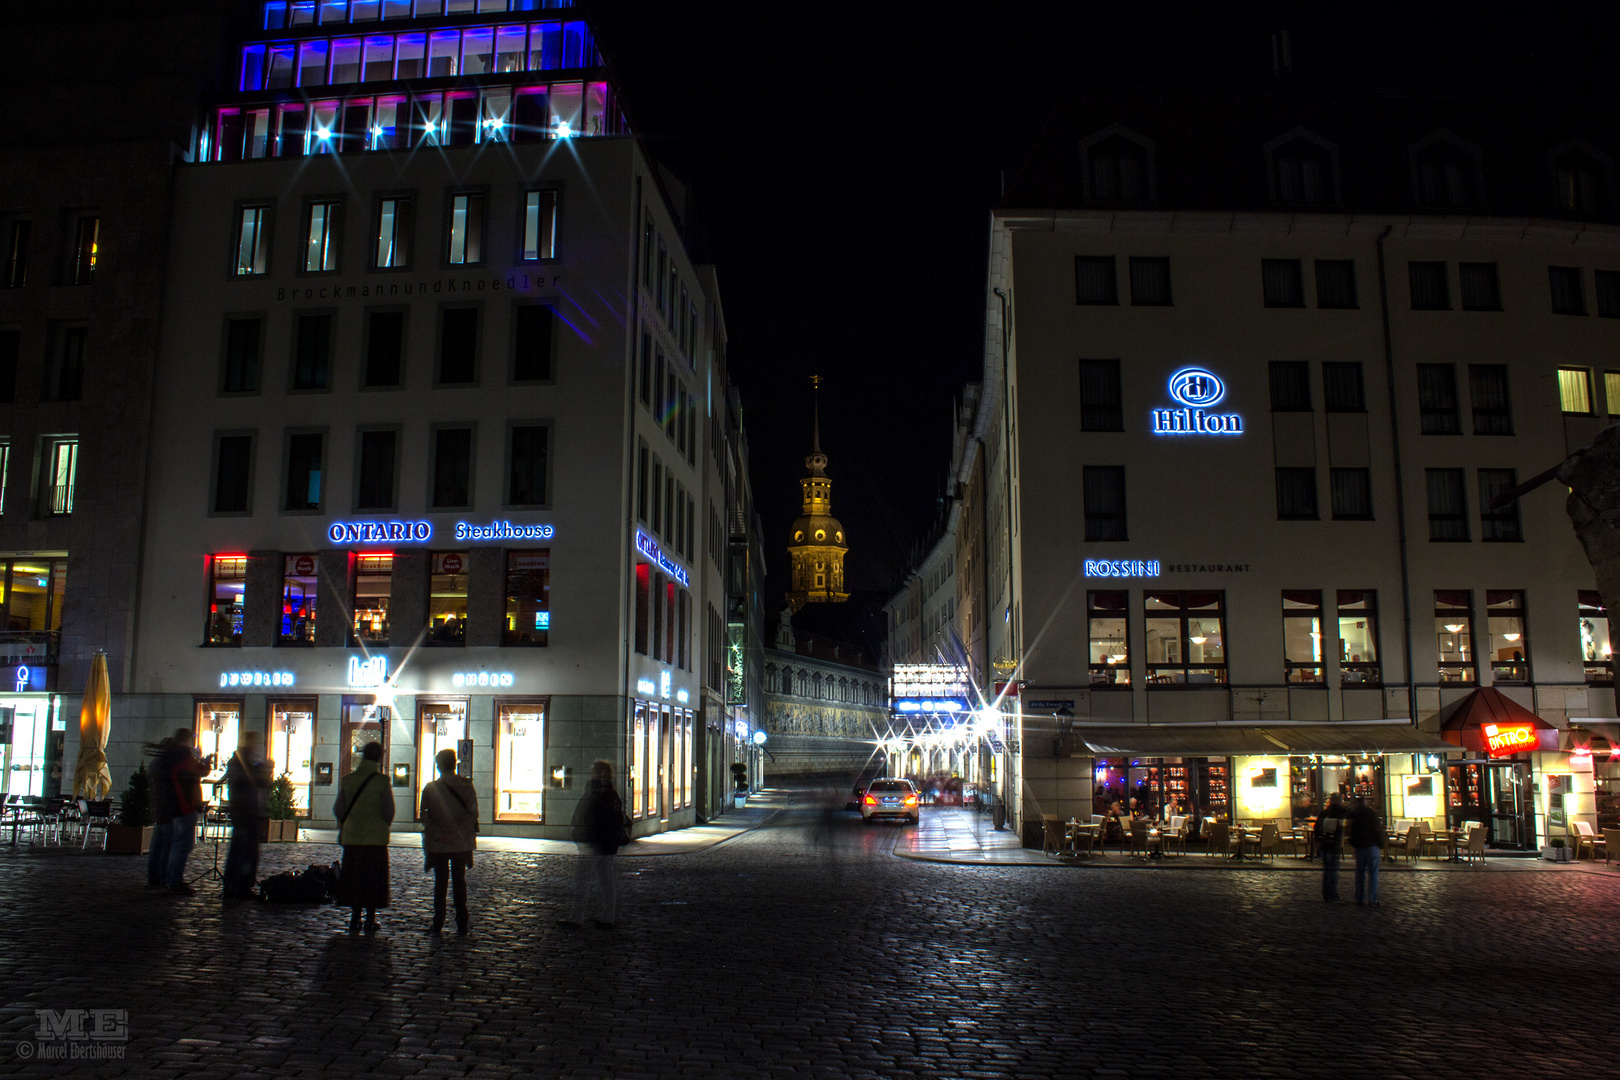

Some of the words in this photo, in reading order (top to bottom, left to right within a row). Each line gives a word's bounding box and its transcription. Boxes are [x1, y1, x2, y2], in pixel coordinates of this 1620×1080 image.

[1153, 408, 1243, 433] Hilton
[329, 522, 432, 542] ONTARIO
[456, 521, 553, 540] Steakhouse
[1084, 560, 1160, 577] ROSSINI
[1169, 564, 1251, 573] RESTAURANT
[1488, 728, 1529, 751] BISTRO
